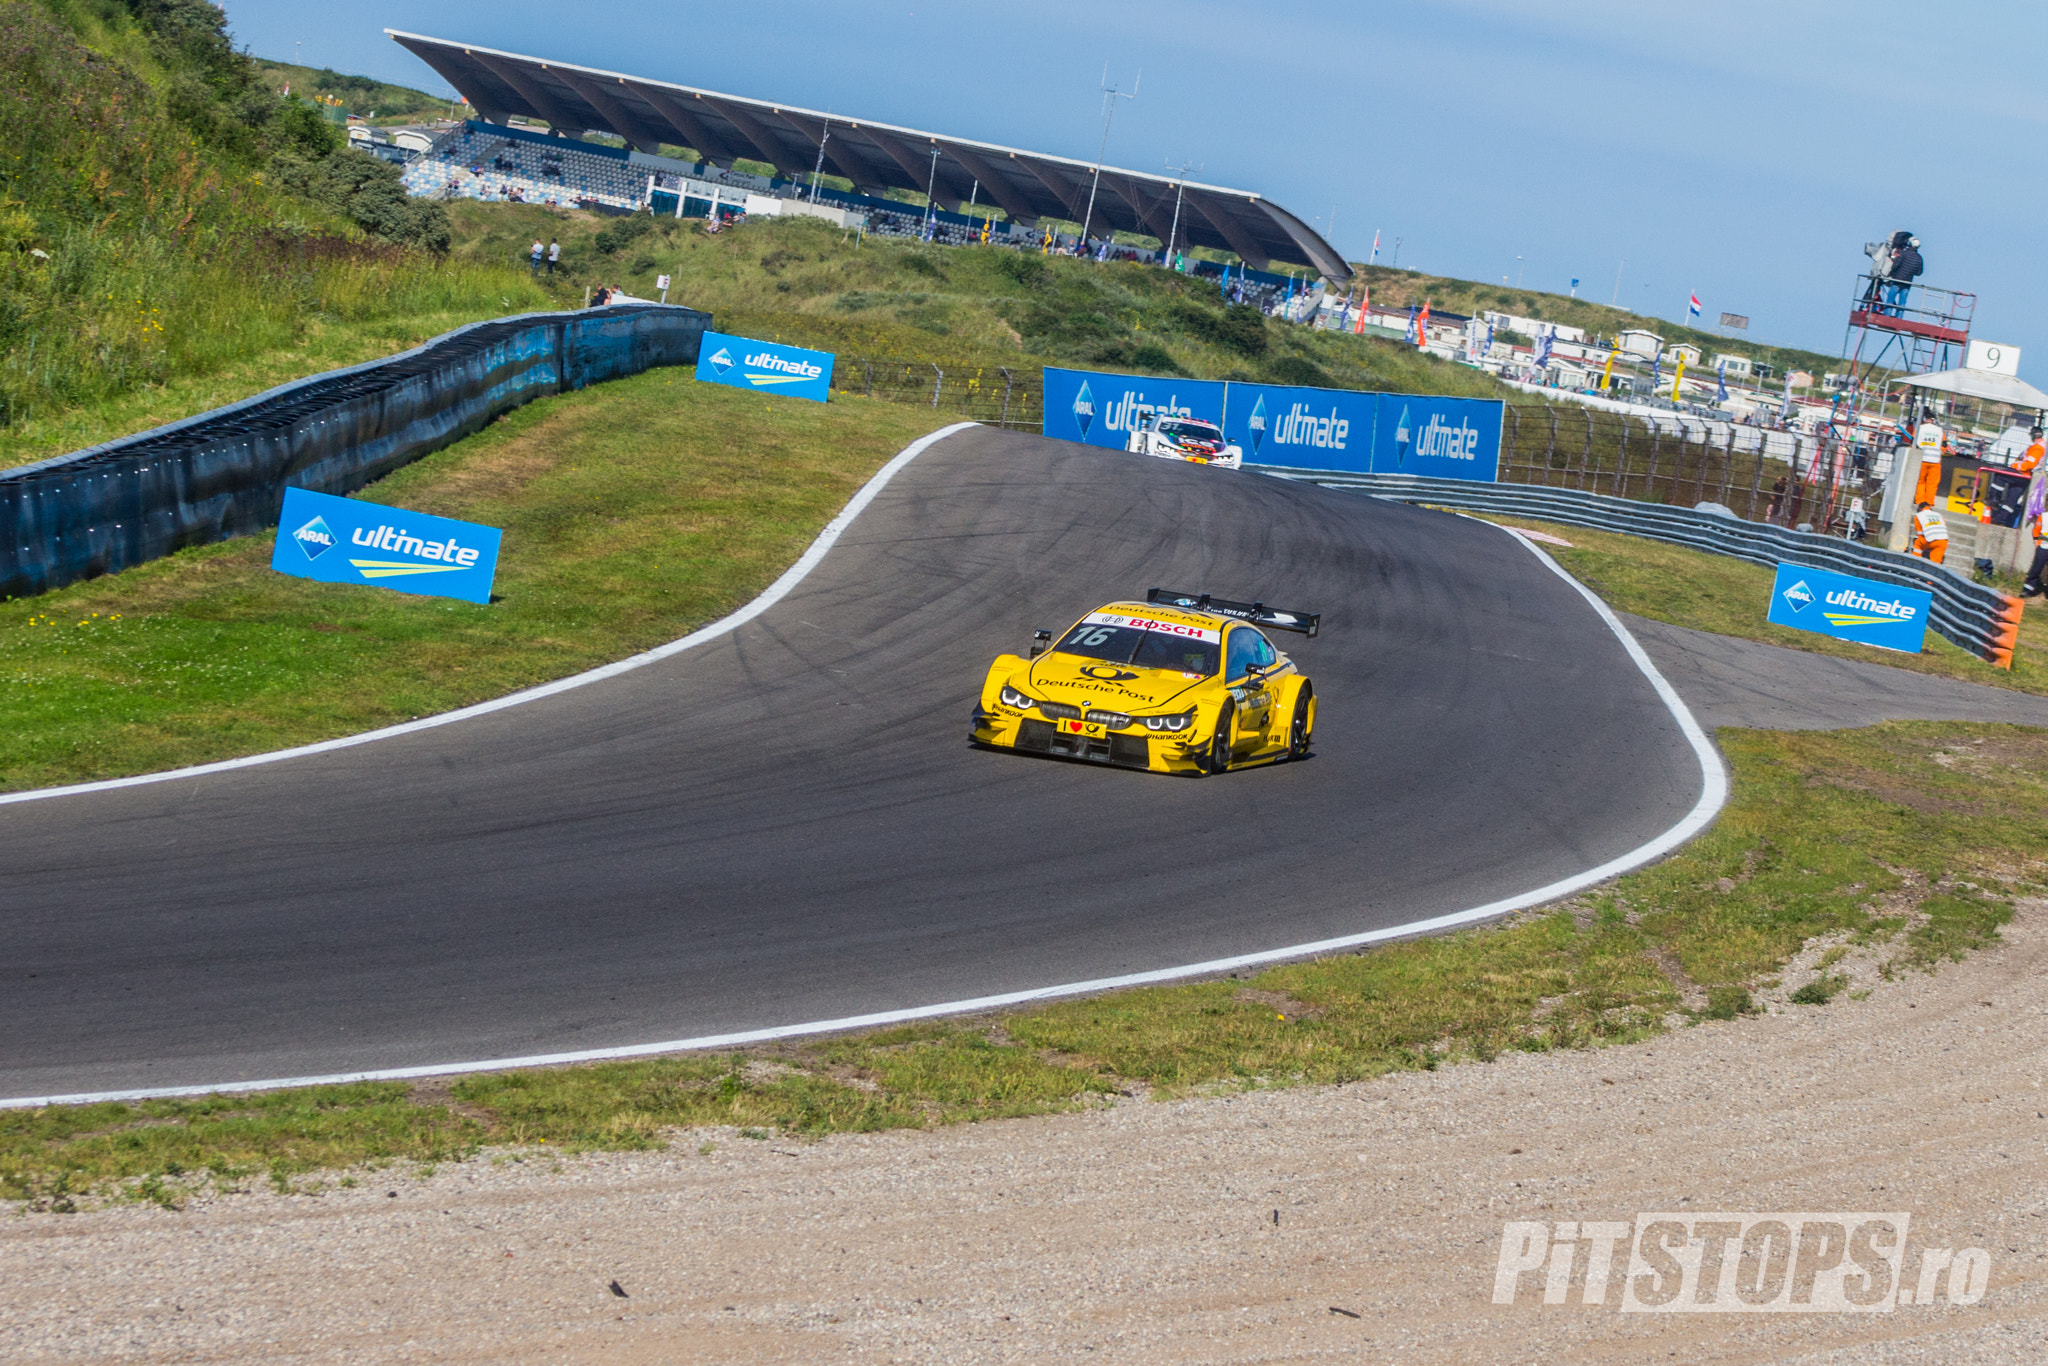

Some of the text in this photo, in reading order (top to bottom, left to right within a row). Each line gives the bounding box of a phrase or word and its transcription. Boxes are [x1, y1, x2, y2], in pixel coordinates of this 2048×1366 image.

[711, 355, 733, 367] ARAL
[744, 353, 823, 378] ultimate
[1986, 347, 2001, 369] 9
[1074, 402, 1095, 416] ARAL
[1250, 415, 1265, 431] ARAL
[1274, 403, 1349, 450] ultimate
[1416, 413, 1478, 461] ultimate
[298, 529, 332, 546] ARAL
[352, 525, 480, 567] ultimate
[1787, 590, 1811, 602] ARAL
[1825, 589, 1916, 619] ultimate
[1108, 605, 1180, 619] Deutsche
[1186, 613, 1214, 627] Post
[1069, 625, 1117, 646] 16
[1129, 618, 1203, 638] BOSCH
[1036, 678, 1156, 703] Deutsche Post
